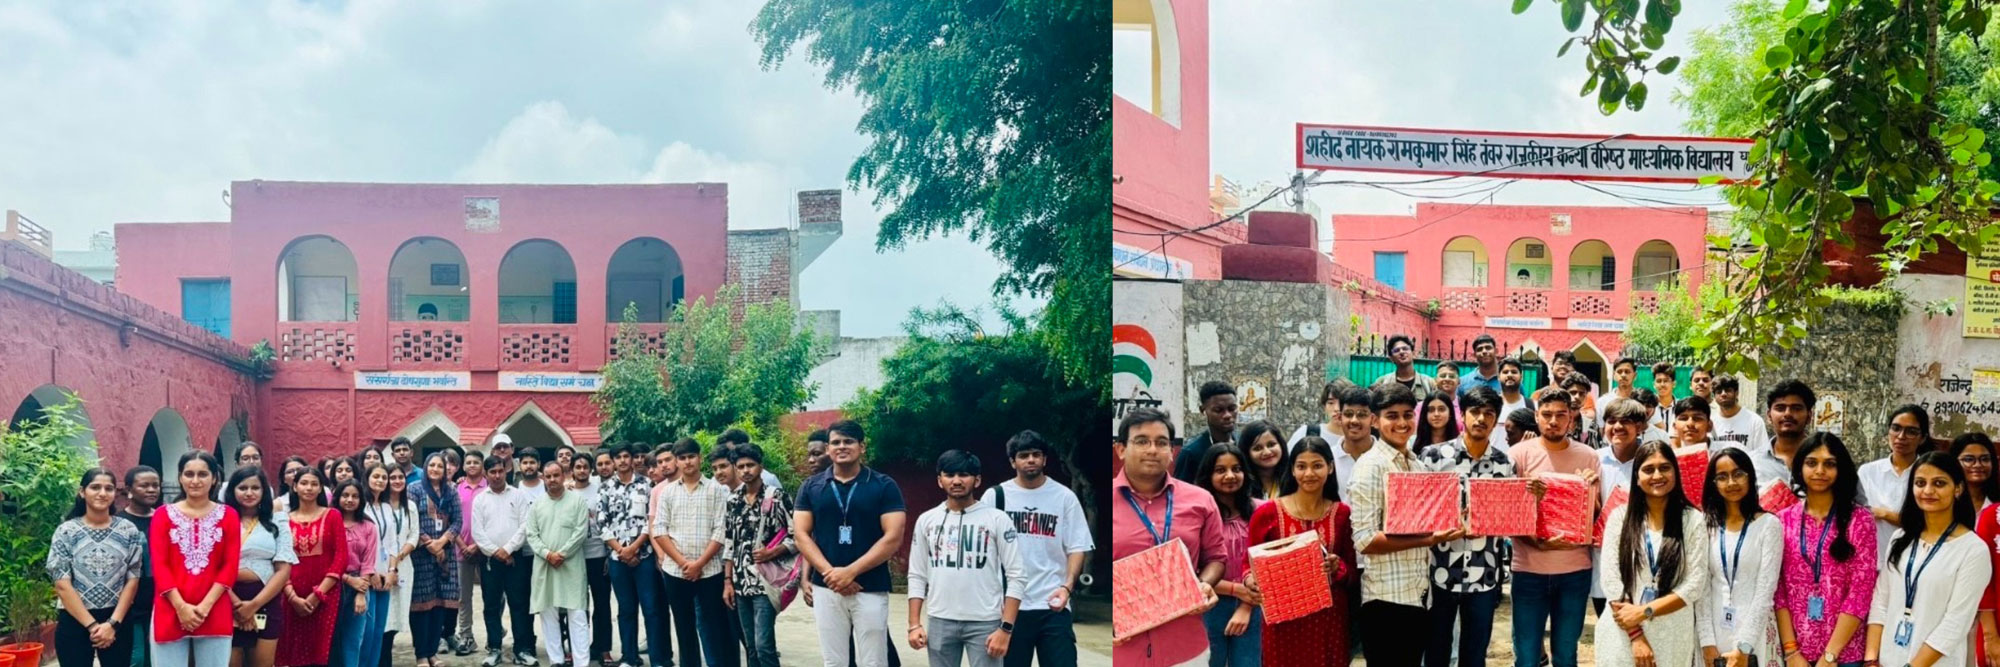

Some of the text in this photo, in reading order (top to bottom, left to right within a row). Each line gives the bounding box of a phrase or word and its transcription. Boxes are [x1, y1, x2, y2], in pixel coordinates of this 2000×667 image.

[1306, 130, 1343, 162] शहीद
[1345, 137, 1386, 161] नायक
[1386, 139, 1450, 168] रामकुमार
[1451, 137, 1478, 166] सिंह
[1480, 138, 1504, 167] तंवर
[1505, 140, 1555, 167] राजकीय
[1556, 145, 1589, 169] कन्या
[1590, 142, 1626, 171] वरिष्ठ
[1627, 144, 1684, 171] माध्यमिक
[1685, 144, 1735, 172] विद्यालय
